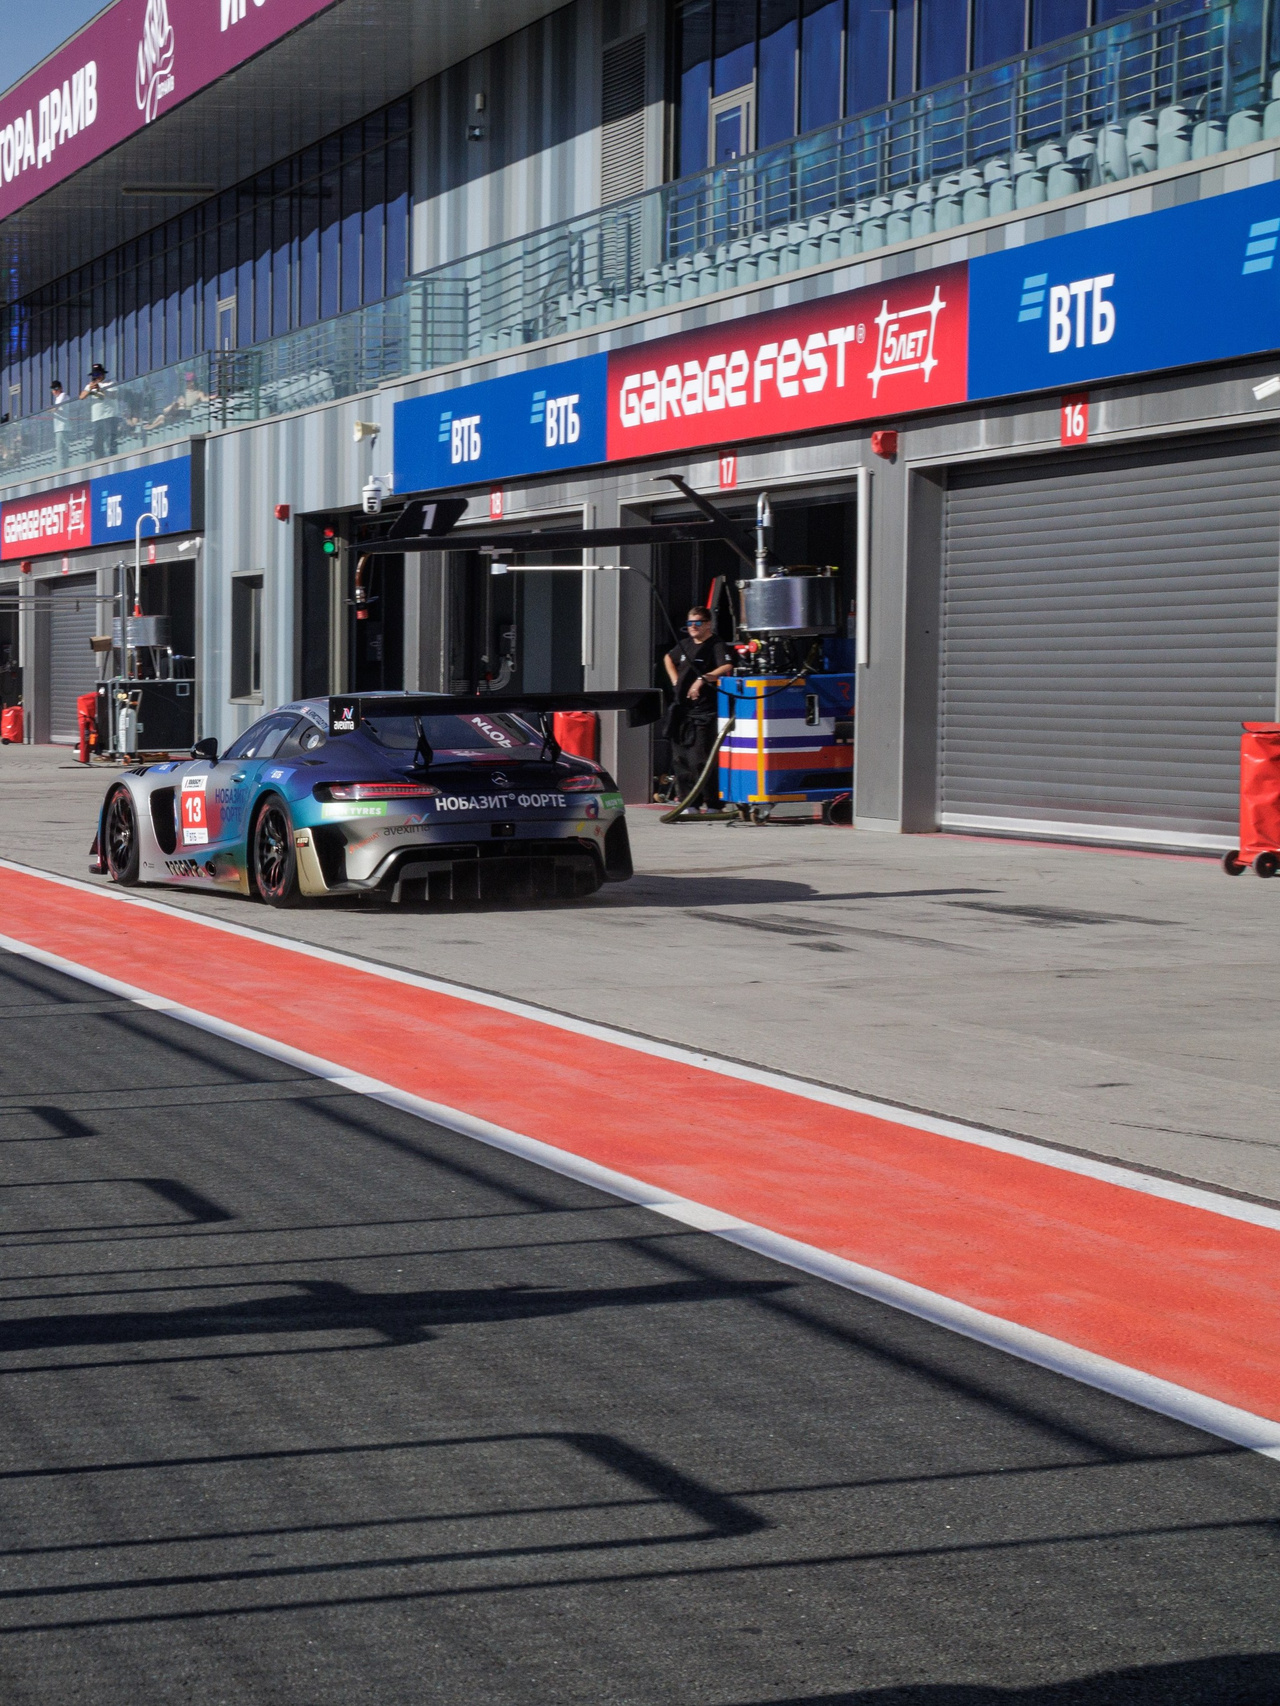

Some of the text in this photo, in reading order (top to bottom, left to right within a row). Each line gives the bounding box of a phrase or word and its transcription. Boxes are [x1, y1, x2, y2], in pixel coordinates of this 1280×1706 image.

[1048, 273, 1116, 354] ВТБ
[546, 394, 580, 447] ВТБ
[1064, 403, 1085, 437] 16
[451, 415, 481, 464] ВТБ
[721, 456, 735, 484] 17
[106, 495, 122, 528] ВТБ
[151, 485, 169, 519] ВТБ
[491, 492, 502, 515] 18
[422, 503, 438, 530] 1
[333, 719, 355, 730] avexima
[185, 797, 202, 823] 13
[350, 807, 382, 815] TYRES
[518, 794, 566, 808] ФОРТЕ
[383, 824, 430, 836] avexima
